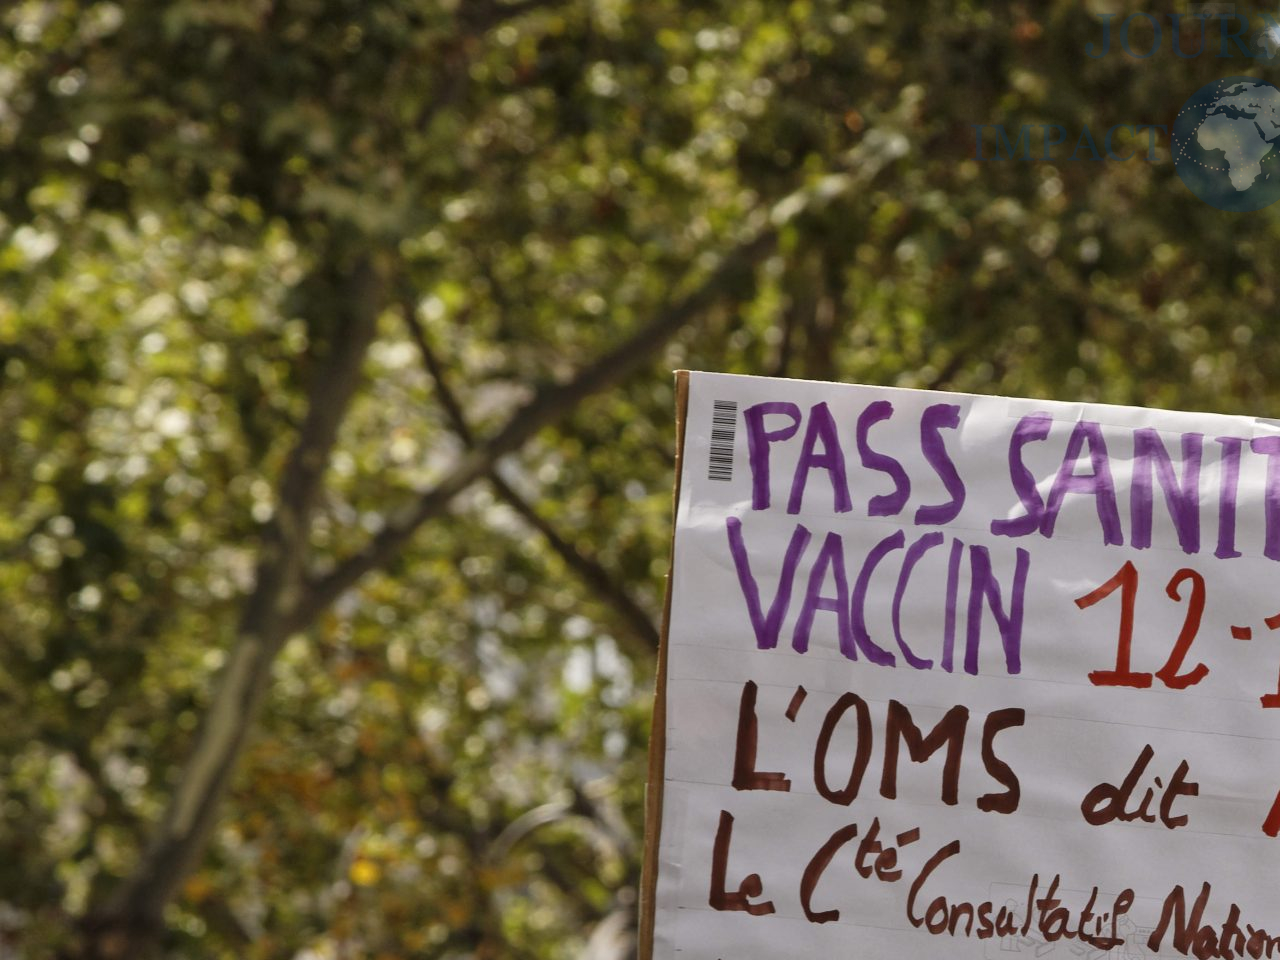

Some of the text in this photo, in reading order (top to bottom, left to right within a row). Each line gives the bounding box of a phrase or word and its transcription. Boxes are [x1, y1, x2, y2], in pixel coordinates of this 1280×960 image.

[743, 401, 966, 525] PASS
[727, 517, 1030, 675] VACCIN
[732, 680, 1026, 814] L'OMS
[1081, 744, 1200, 828] dit
[709, 810, 775, 915] Le
[907, 840, 1135, 949] Consultatif
